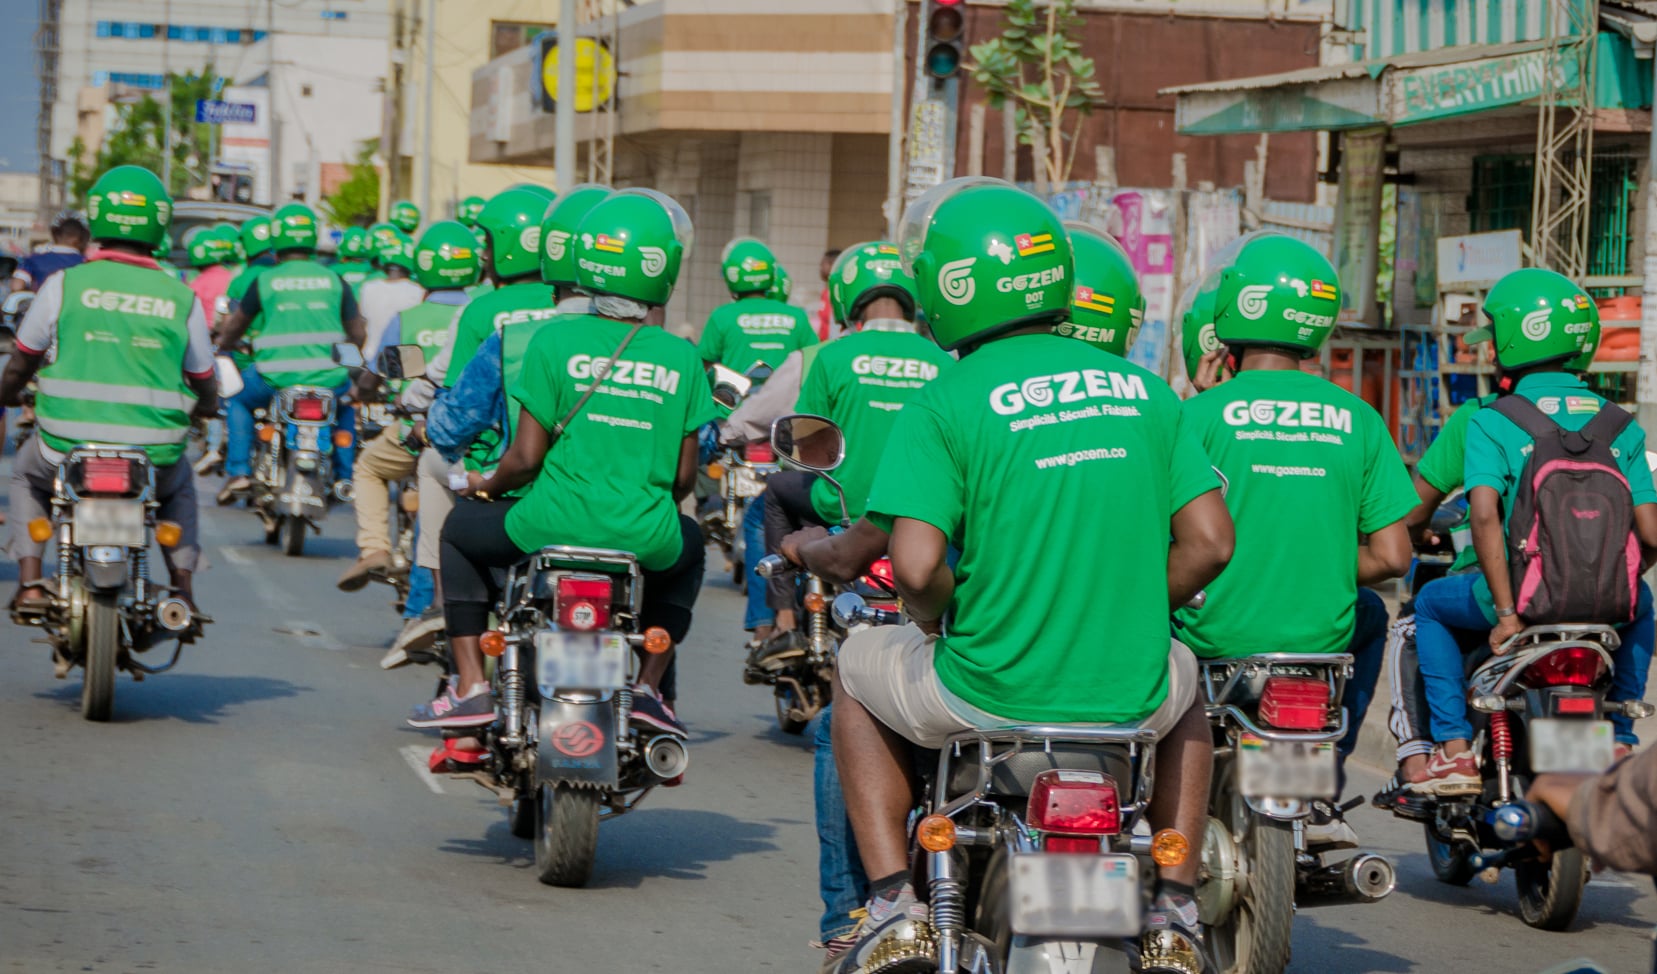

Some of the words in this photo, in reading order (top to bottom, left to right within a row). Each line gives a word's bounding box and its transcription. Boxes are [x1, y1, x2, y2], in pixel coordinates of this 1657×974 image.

[996, 265, 1065, 293] GOZEM
[80, 288, 176, 320] GOZEM
[1025, 291, 1045, 304] DOT
[1282, 308, 1334, 328] GOZEM
[1051, 321, 1115, 343] OZEM
[567, 354, 681, 395] GOZEM
[989, 369, 1149, 416] GOZEM
[1222, 399, 1353, 434] GOZEM
[1035, 447, 1127, 470] www.gozem.co
[1251, 463, 1326, 477] www.gozem.co
